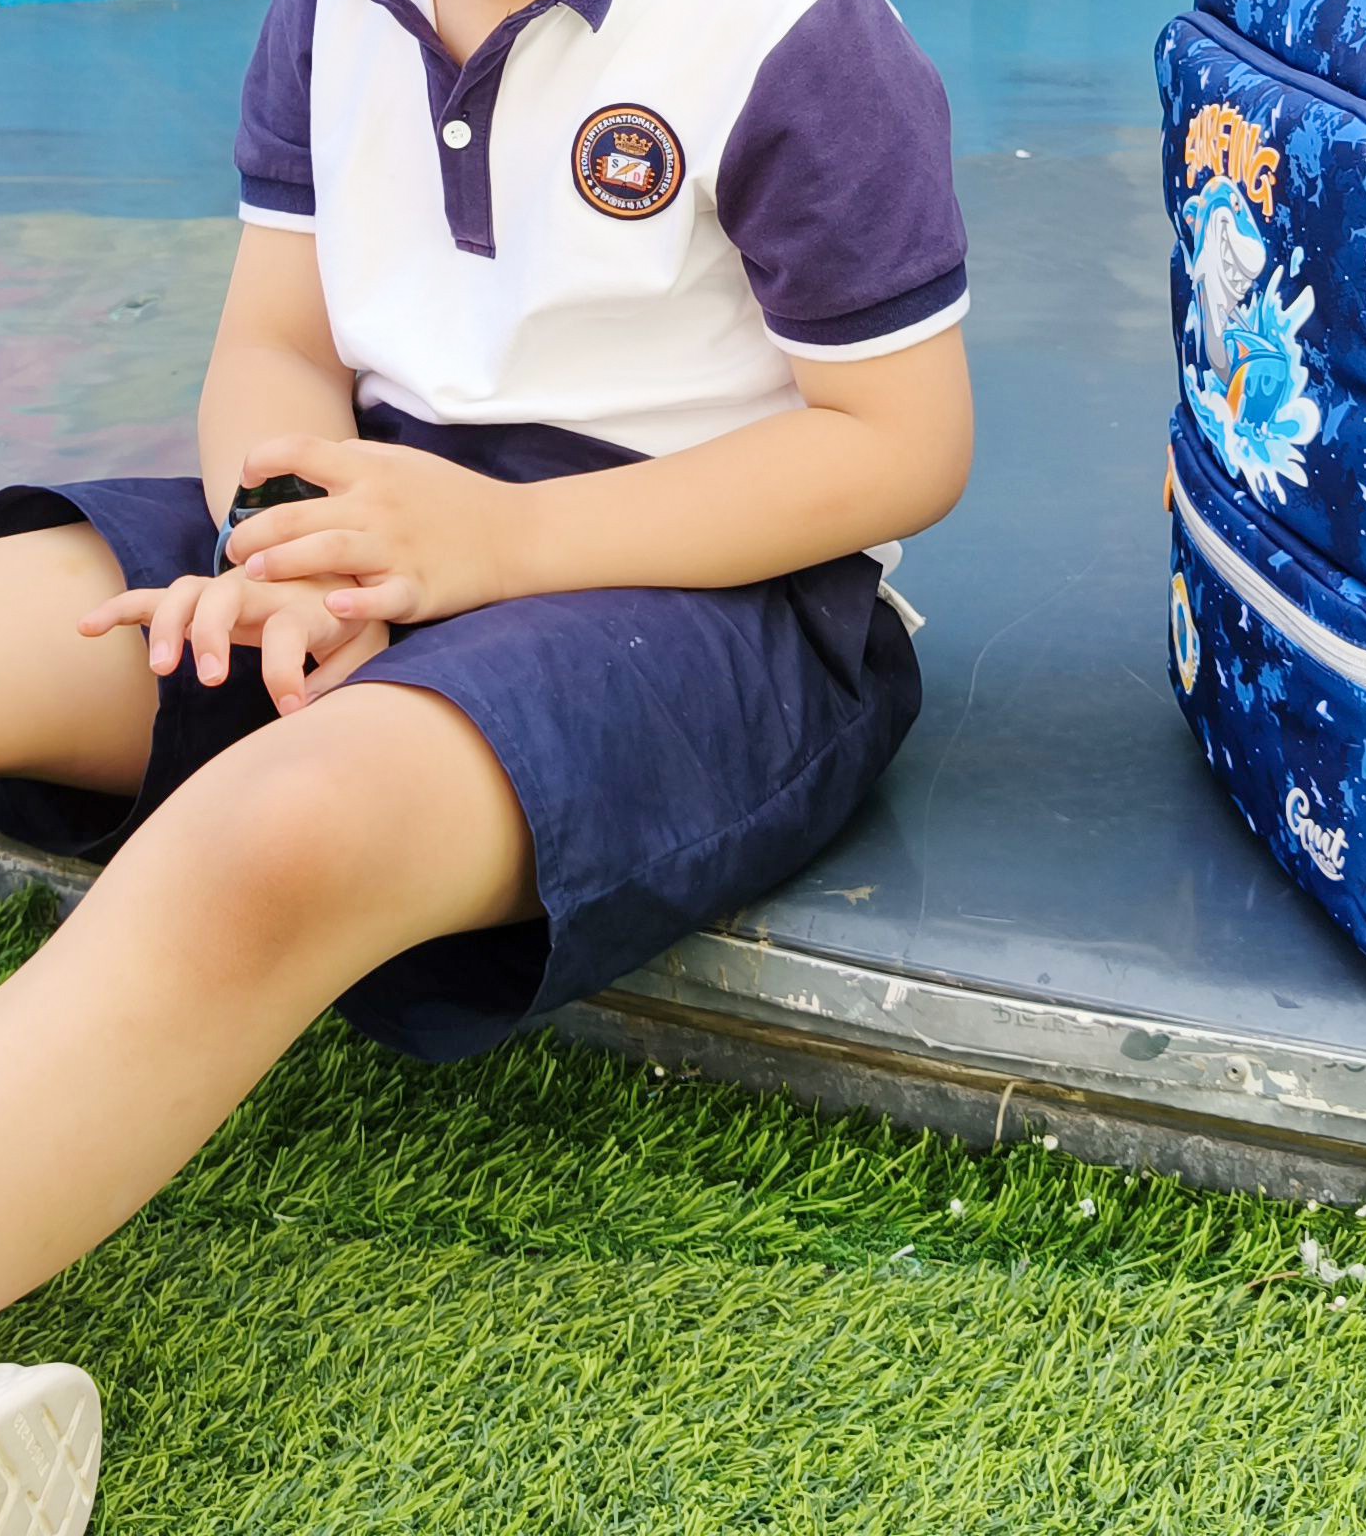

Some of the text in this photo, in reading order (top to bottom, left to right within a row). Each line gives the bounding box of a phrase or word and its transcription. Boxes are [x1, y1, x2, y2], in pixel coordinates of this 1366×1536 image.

[586, 115, 656, 141] INTERNATIONAL
[654, 128, 674, 194] KINDERGARTEN
[611, 158, 620, 169] S
[1185, 102, 1280, 218] SURFING
